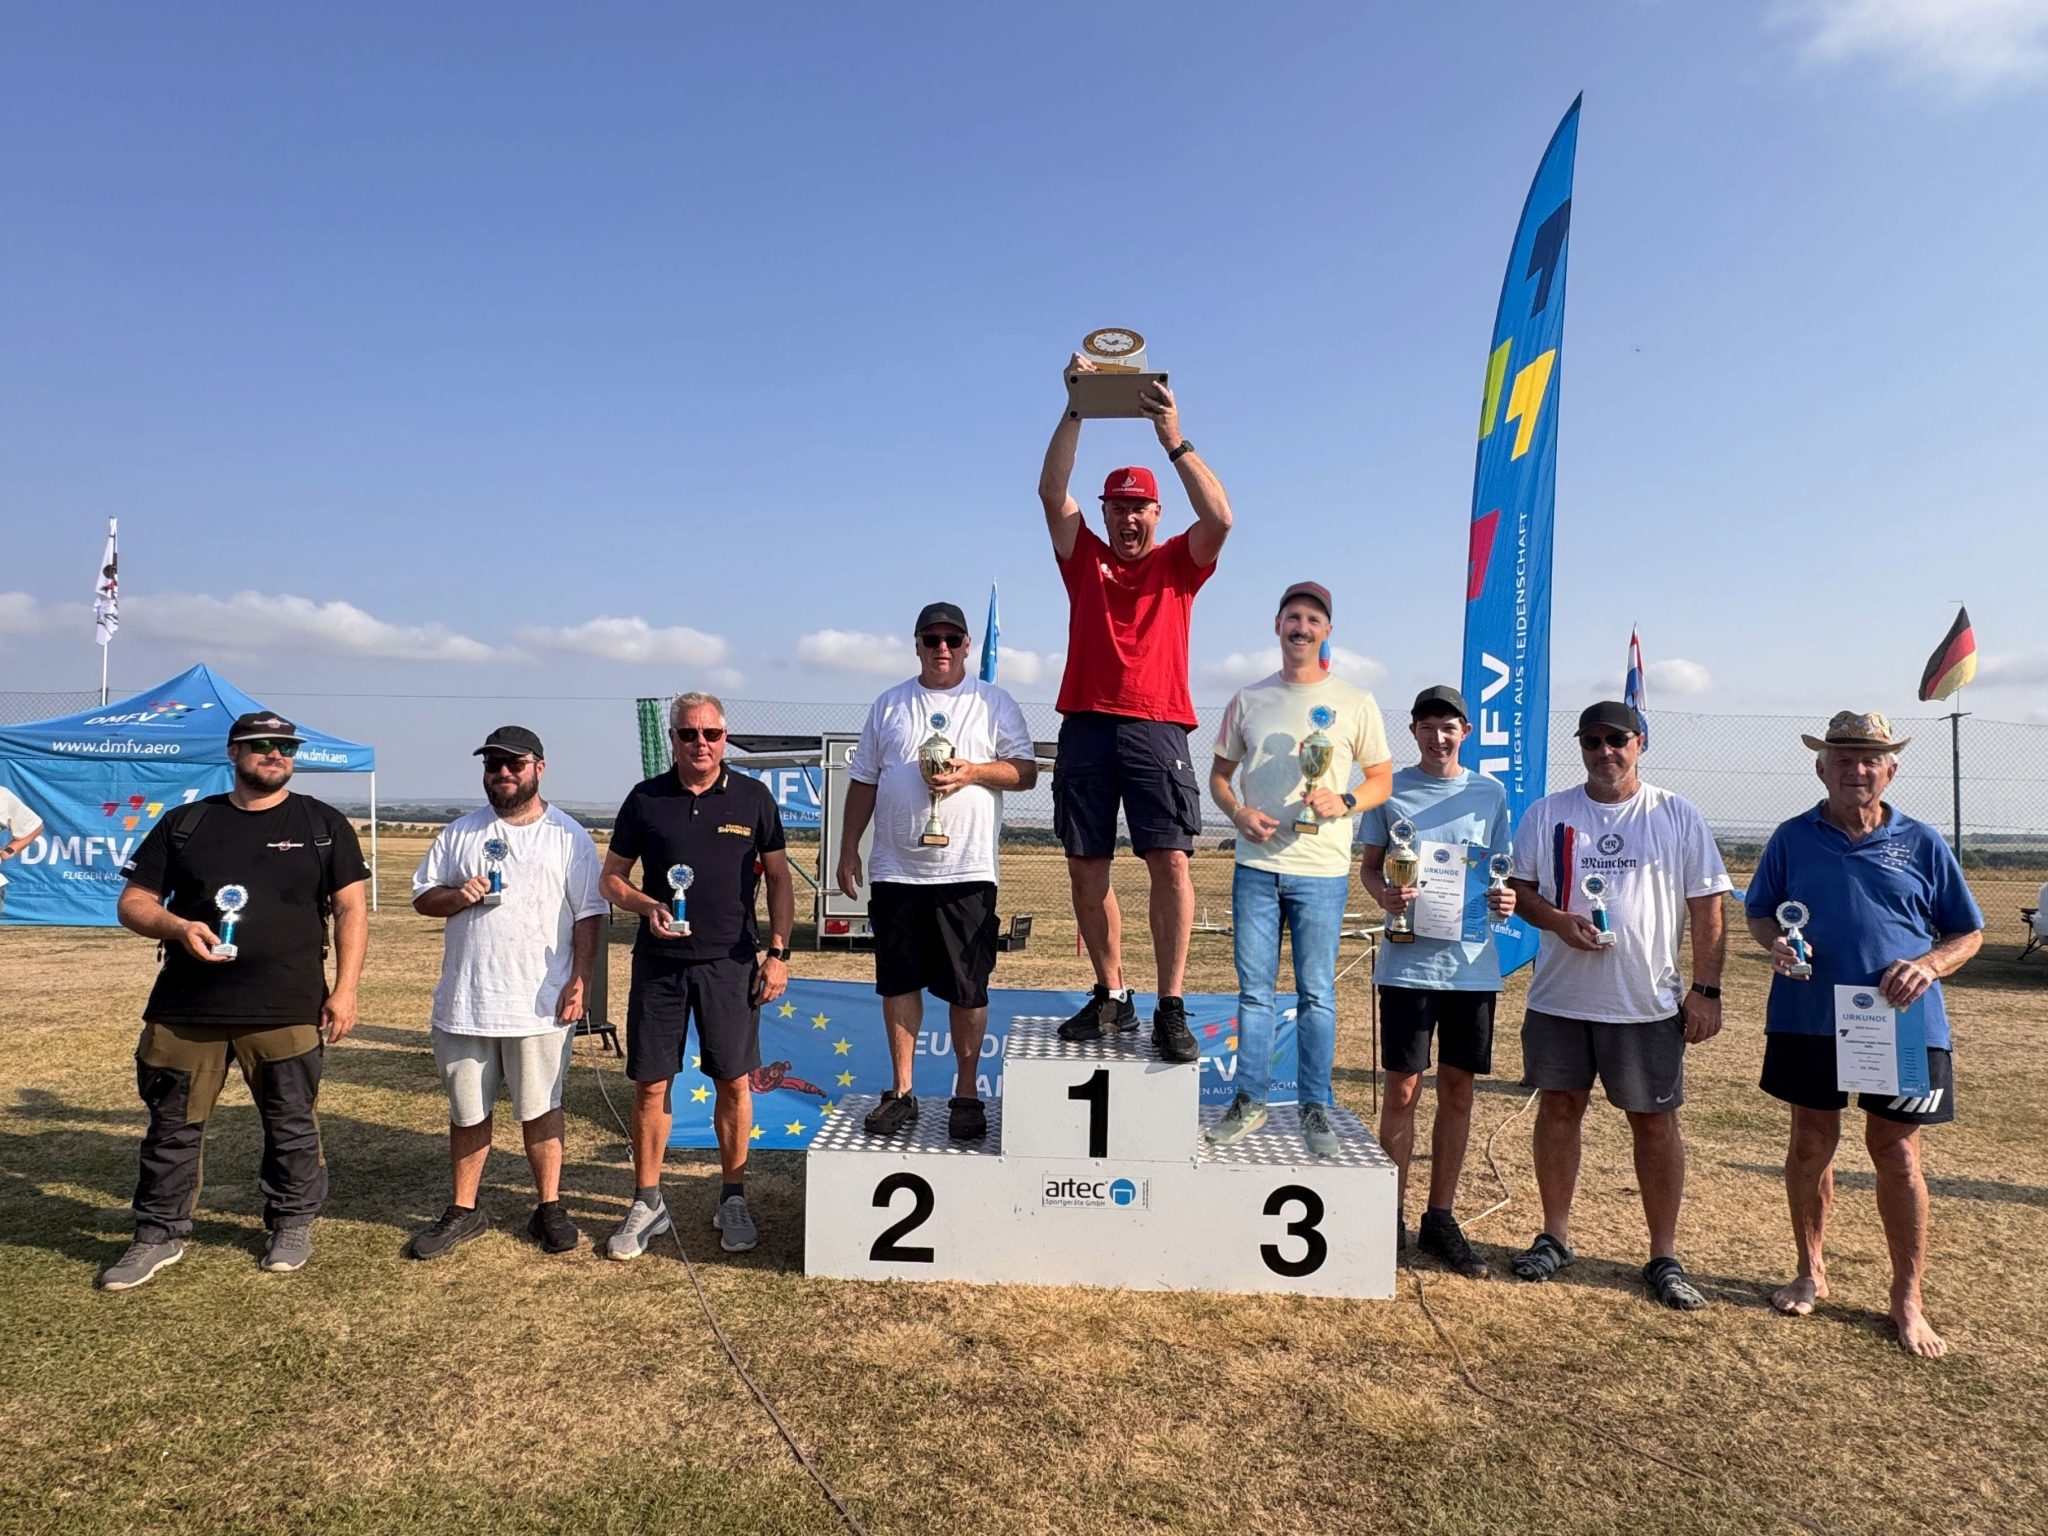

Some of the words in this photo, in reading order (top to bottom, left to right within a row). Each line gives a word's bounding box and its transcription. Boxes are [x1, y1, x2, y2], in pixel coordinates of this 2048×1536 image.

[1516, 512, 1528, 660] LEIDENSCHAFT
[1514, 665, 1524, 705] AUS
[83, 712, 160, 725] DMFV
[52, 739, 181, 754] www.dmfv.aero
[1514, 712, 1525, 793] FLIEGEN
[20, 835, 135, 867] DMFV
[1581, 857, 1637, 869] München
[1423, 867, 1460, 877] URKUNDE
[1842, 1013, 1888, 1023] URKUNDE
[1213, 1086, 1233, 1095] AUS
[1068, 1069, 1110, 1159] 1
[1046, 1178, 1105, 1199] artec
[869, 1172, 936, 1264] 2
[1260, 1184, 1328, 1278] 3
